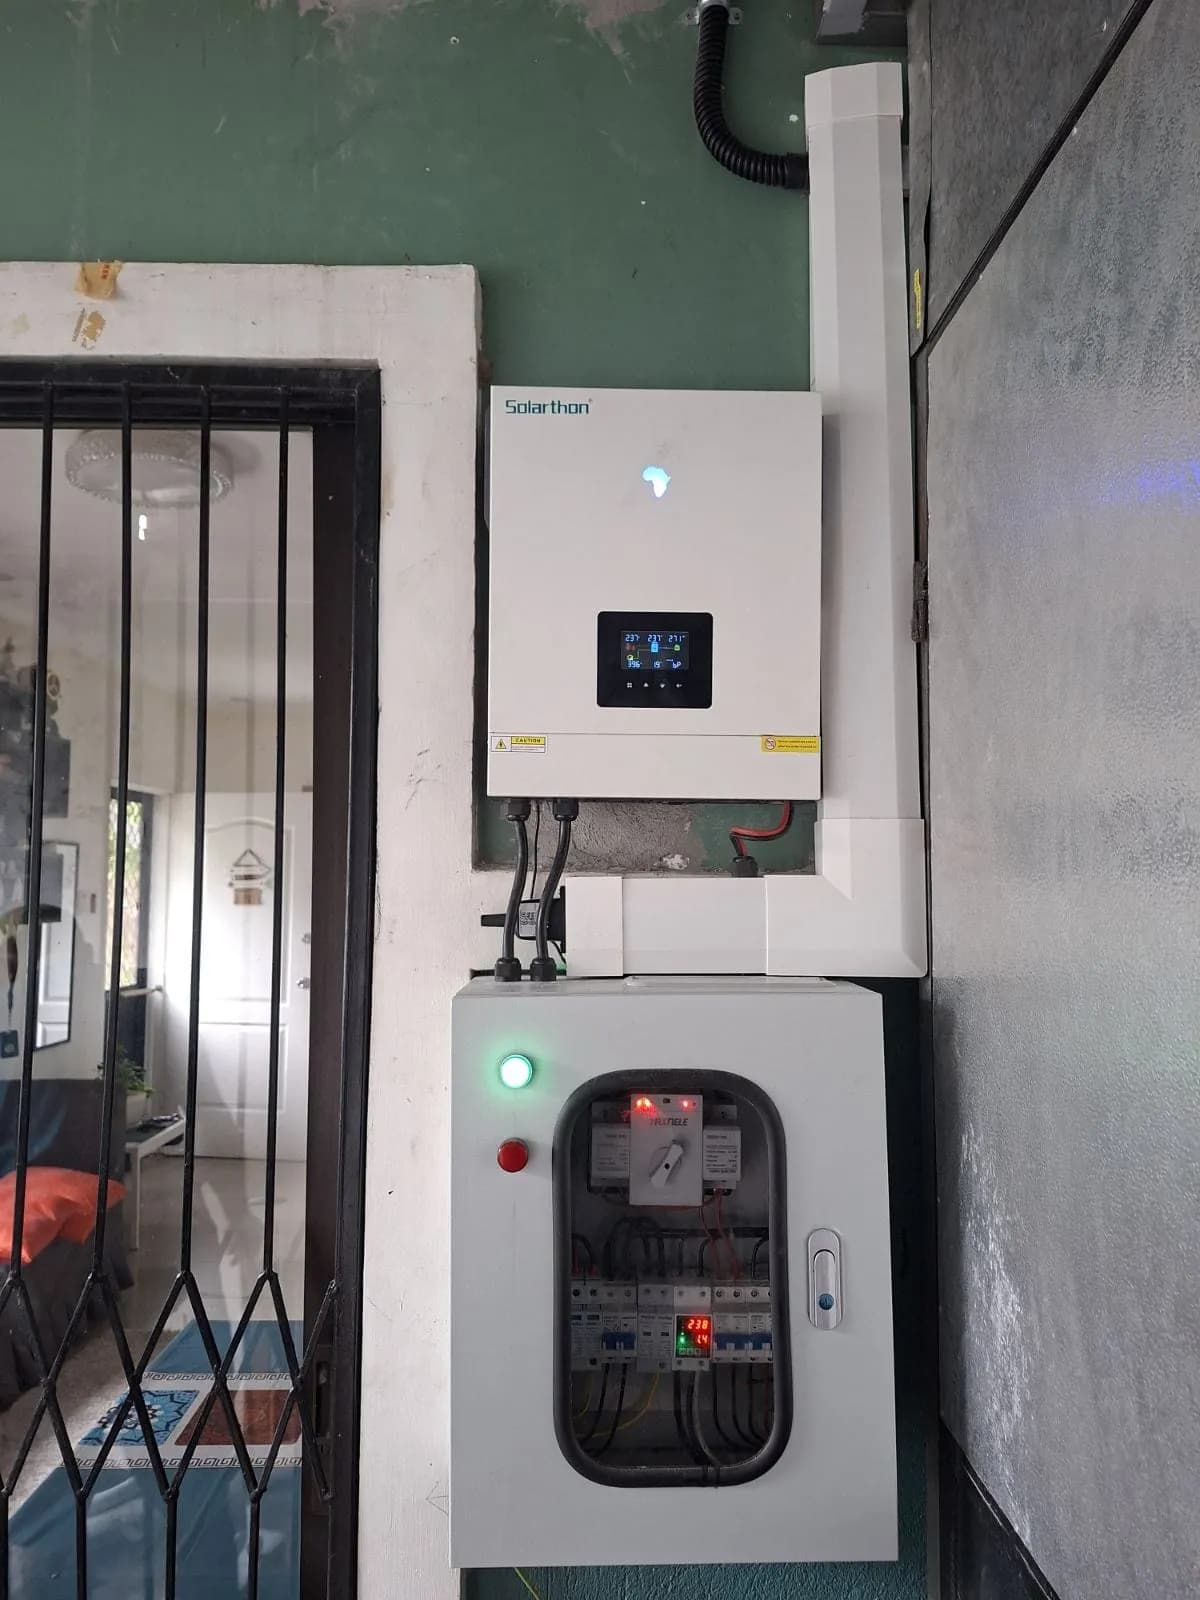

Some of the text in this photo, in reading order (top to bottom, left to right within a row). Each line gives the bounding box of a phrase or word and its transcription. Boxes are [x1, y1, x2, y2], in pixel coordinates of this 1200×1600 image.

[505, 399, 589, 415] Solarthon
[625, 633, 639, 642] 237
[647, 634, 661, 642] 237
[687, 1319, 709, 1330] 238
